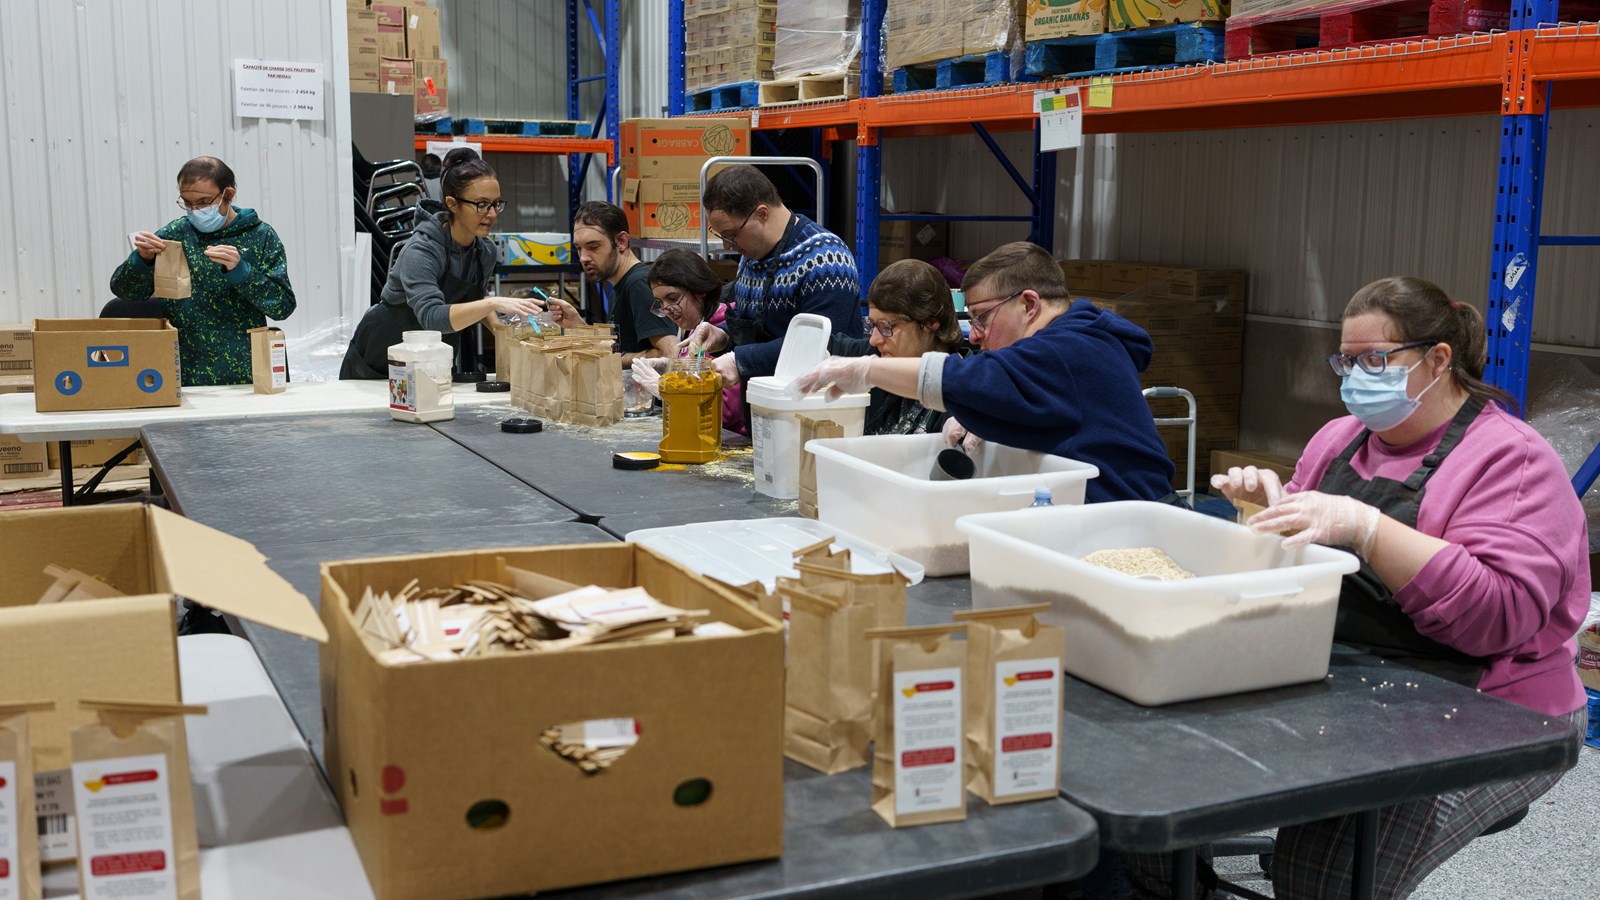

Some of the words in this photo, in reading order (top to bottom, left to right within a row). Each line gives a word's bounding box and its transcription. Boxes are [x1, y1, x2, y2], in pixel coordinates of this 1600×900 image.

[1034, 15, 1059, 26] ORGANIC
[1060, 12, 1090, 23] BANANAS
[656, 139, 699, 148] CABBAGE
[0, 445, 22, 453] veeno
